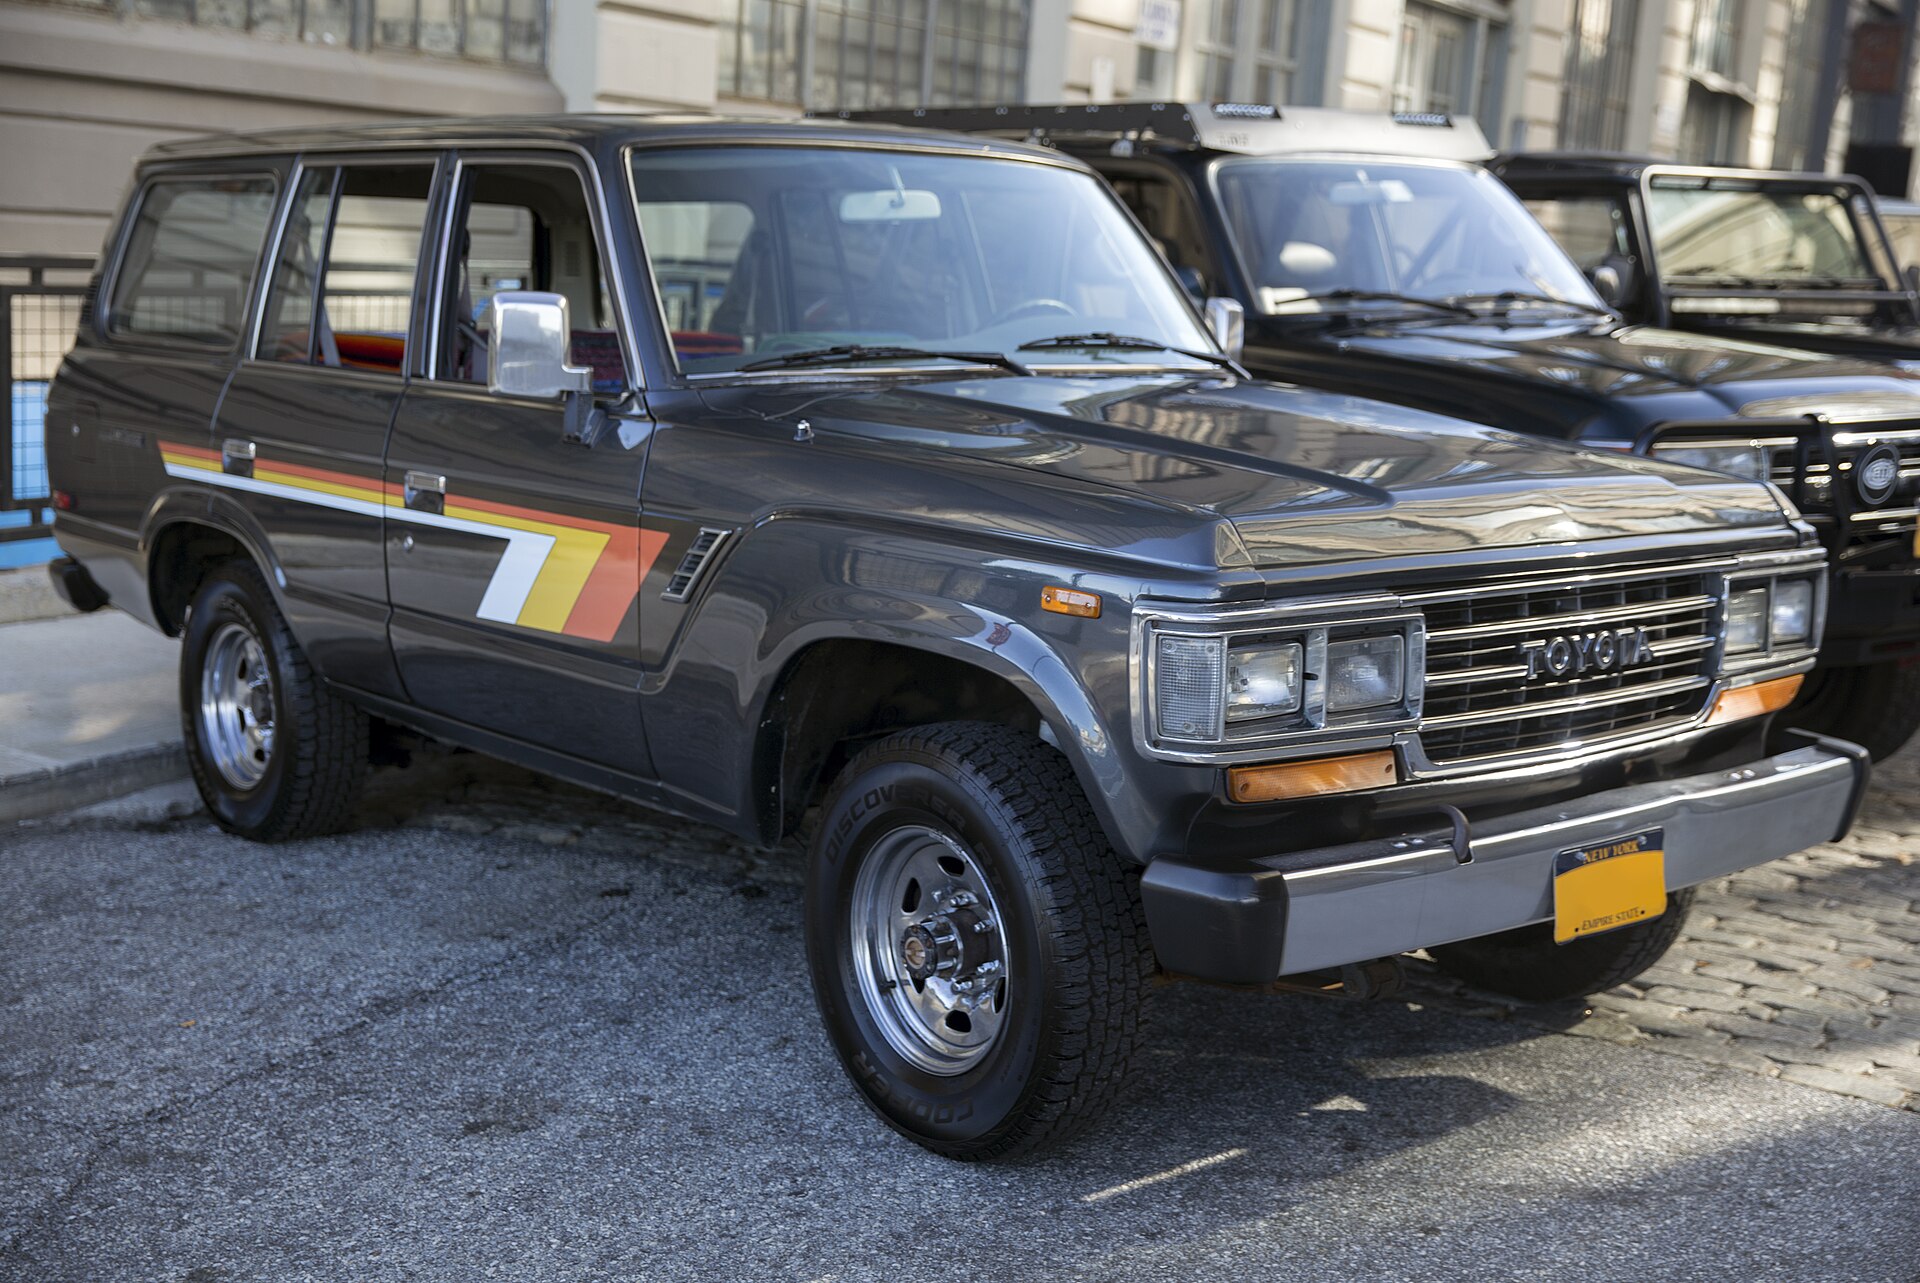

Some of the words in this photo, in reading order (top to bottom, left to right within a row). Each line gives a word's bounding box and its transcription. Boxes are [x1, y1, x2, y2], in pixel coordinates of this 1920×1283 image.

[1520, 625, 1652, 680] TOYOTA
[824, 784, 967, 866] DISCOVERER
[1583, 844, 1611, 864] NEW
[1613, 840, 1639, 856] YORK
[1581, 915, 1613, 931] EMPIRE
[1616, 907, 1640, 922] STATE
[851, 1050, 974, 1124] COOPER
